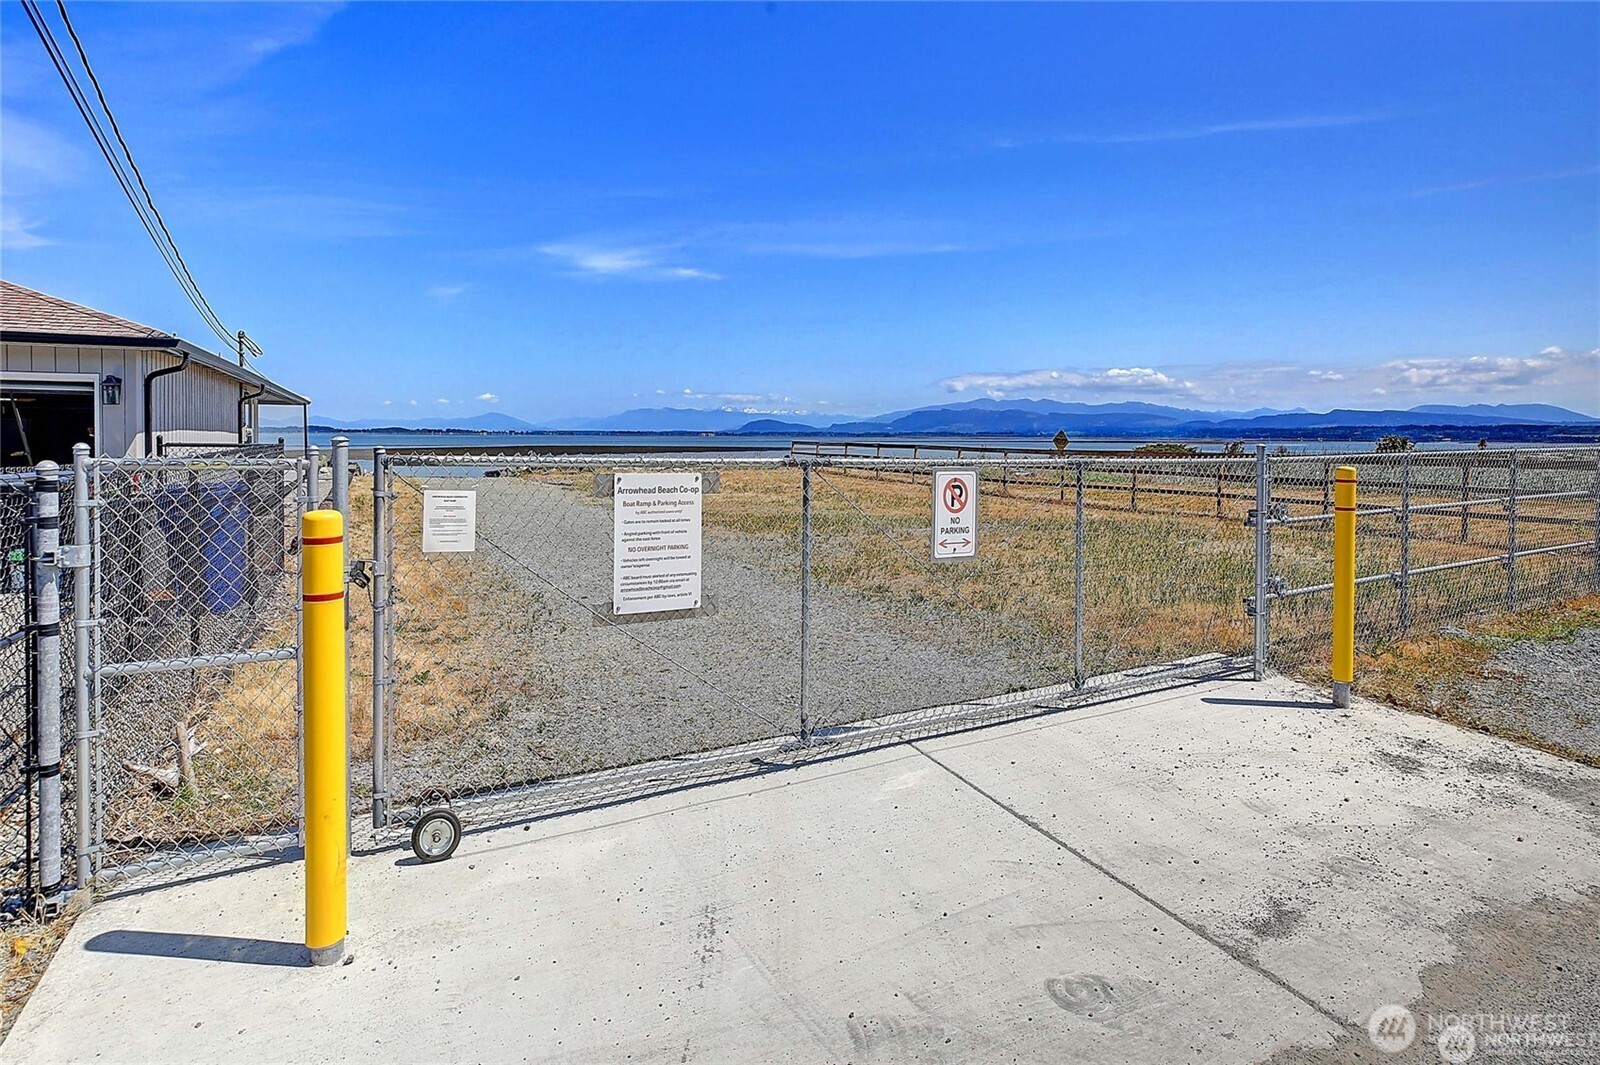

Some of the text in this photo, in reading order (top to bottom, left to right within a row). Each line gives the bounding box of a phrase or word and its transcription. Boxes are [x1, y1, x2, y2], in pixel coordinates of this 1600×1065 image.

[617, 485, 699, 495] Arrowhead Beach Co-op
[940, 526, 970, 535] PARKING
